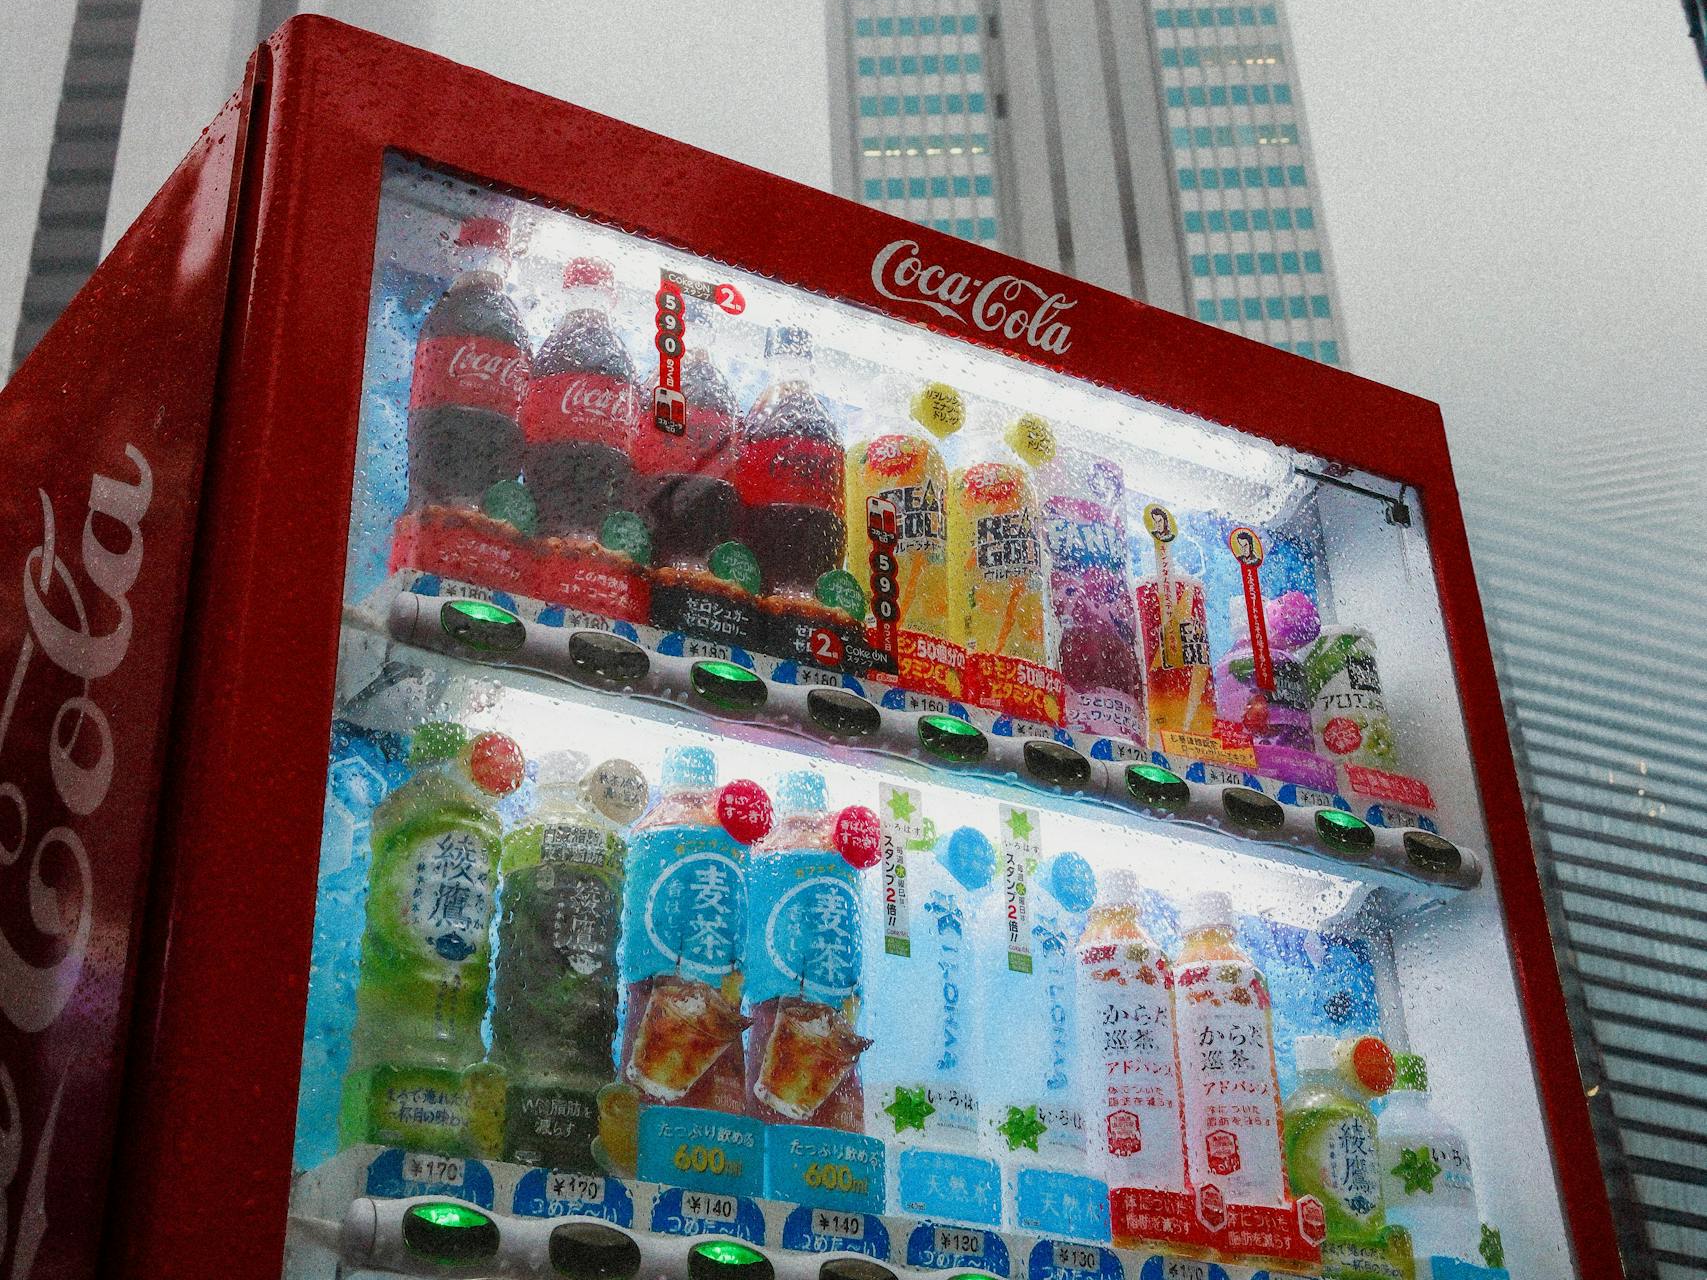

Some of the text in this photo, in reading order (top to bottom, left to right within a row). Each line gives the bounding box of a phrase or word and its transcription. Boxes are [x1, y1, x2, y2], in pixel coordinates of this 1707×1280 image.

[871, 239, 1078, 355] Coca-Cola
[910, 696, 944, 713] ¥160
[429, 832, 478, 931] 綾鷹
[690, 865, 732, 960] 麦茶
[811, 887, 851, 983] 麦茶
[1338, 1119, 1370, 1195] 綾鷹
